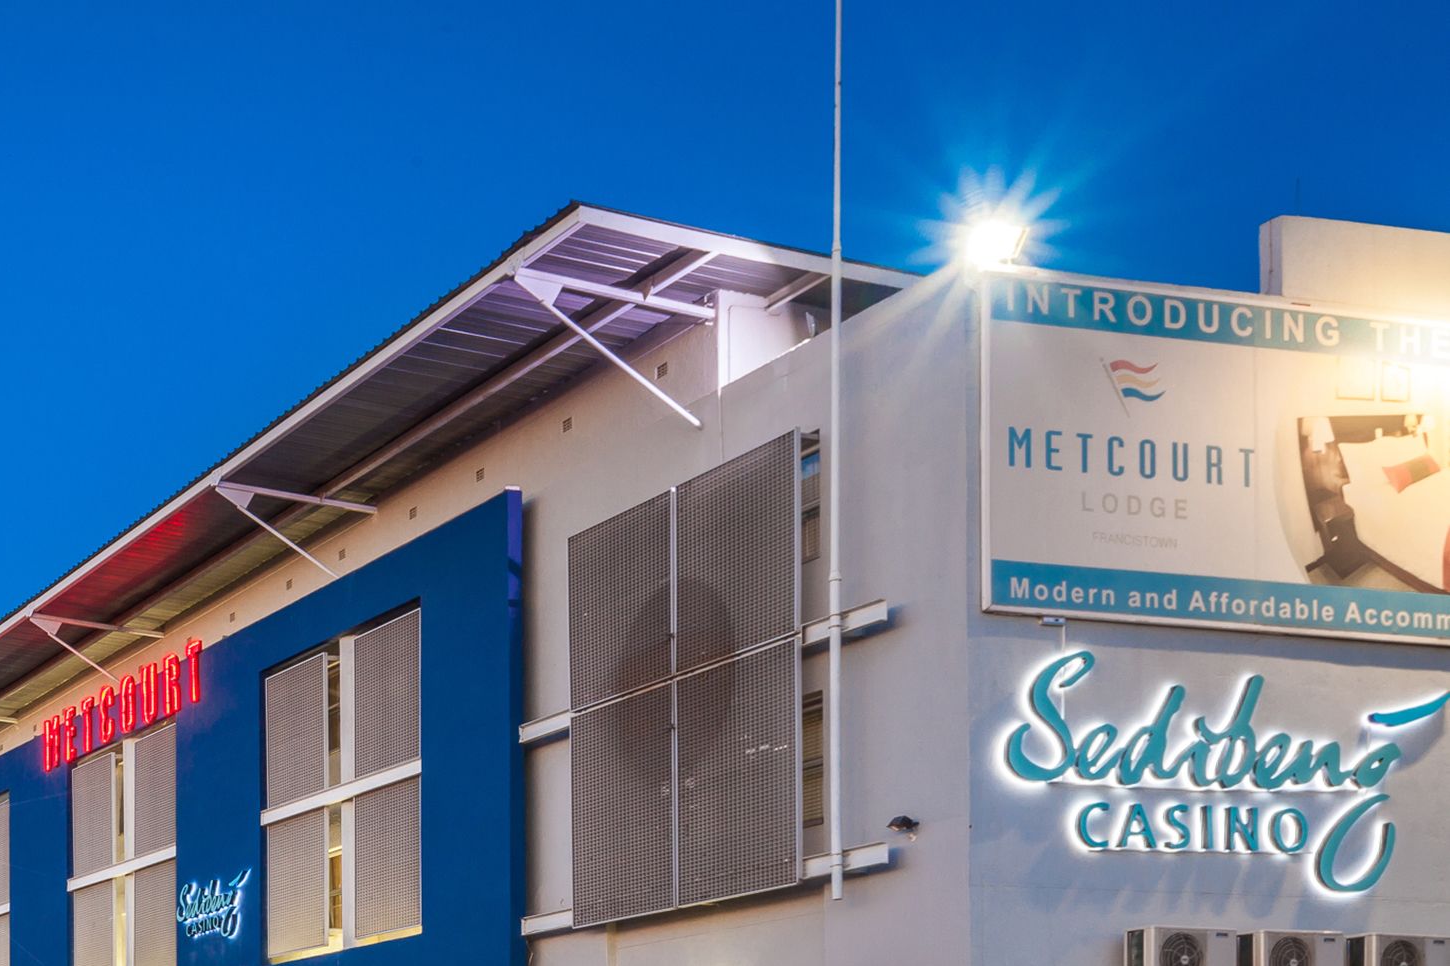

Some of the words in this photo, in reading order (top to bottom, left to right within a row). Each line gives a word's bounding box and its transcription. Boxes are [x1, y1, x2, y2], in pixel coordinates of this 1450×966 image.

[1005, 281, 1340, 347] INTRODUCING
[1369, 321, 1450, 360] THE
[1007, 426, 1255, 488] METCOURT
[1081, 491, 1189, 520] LODGE
[1092, 531, 1178, 549] FRANCISTOWN
[1009, 576, 1116, 606] Modern
[1127, 588, 1178, 610] and
[1188, 590, 1335, 623] Affordable
[43, 640, 202, 773] METCOURT
[1075, 801, 1309, 854] CASINO
[186, 915, 219, 937] CASINO
